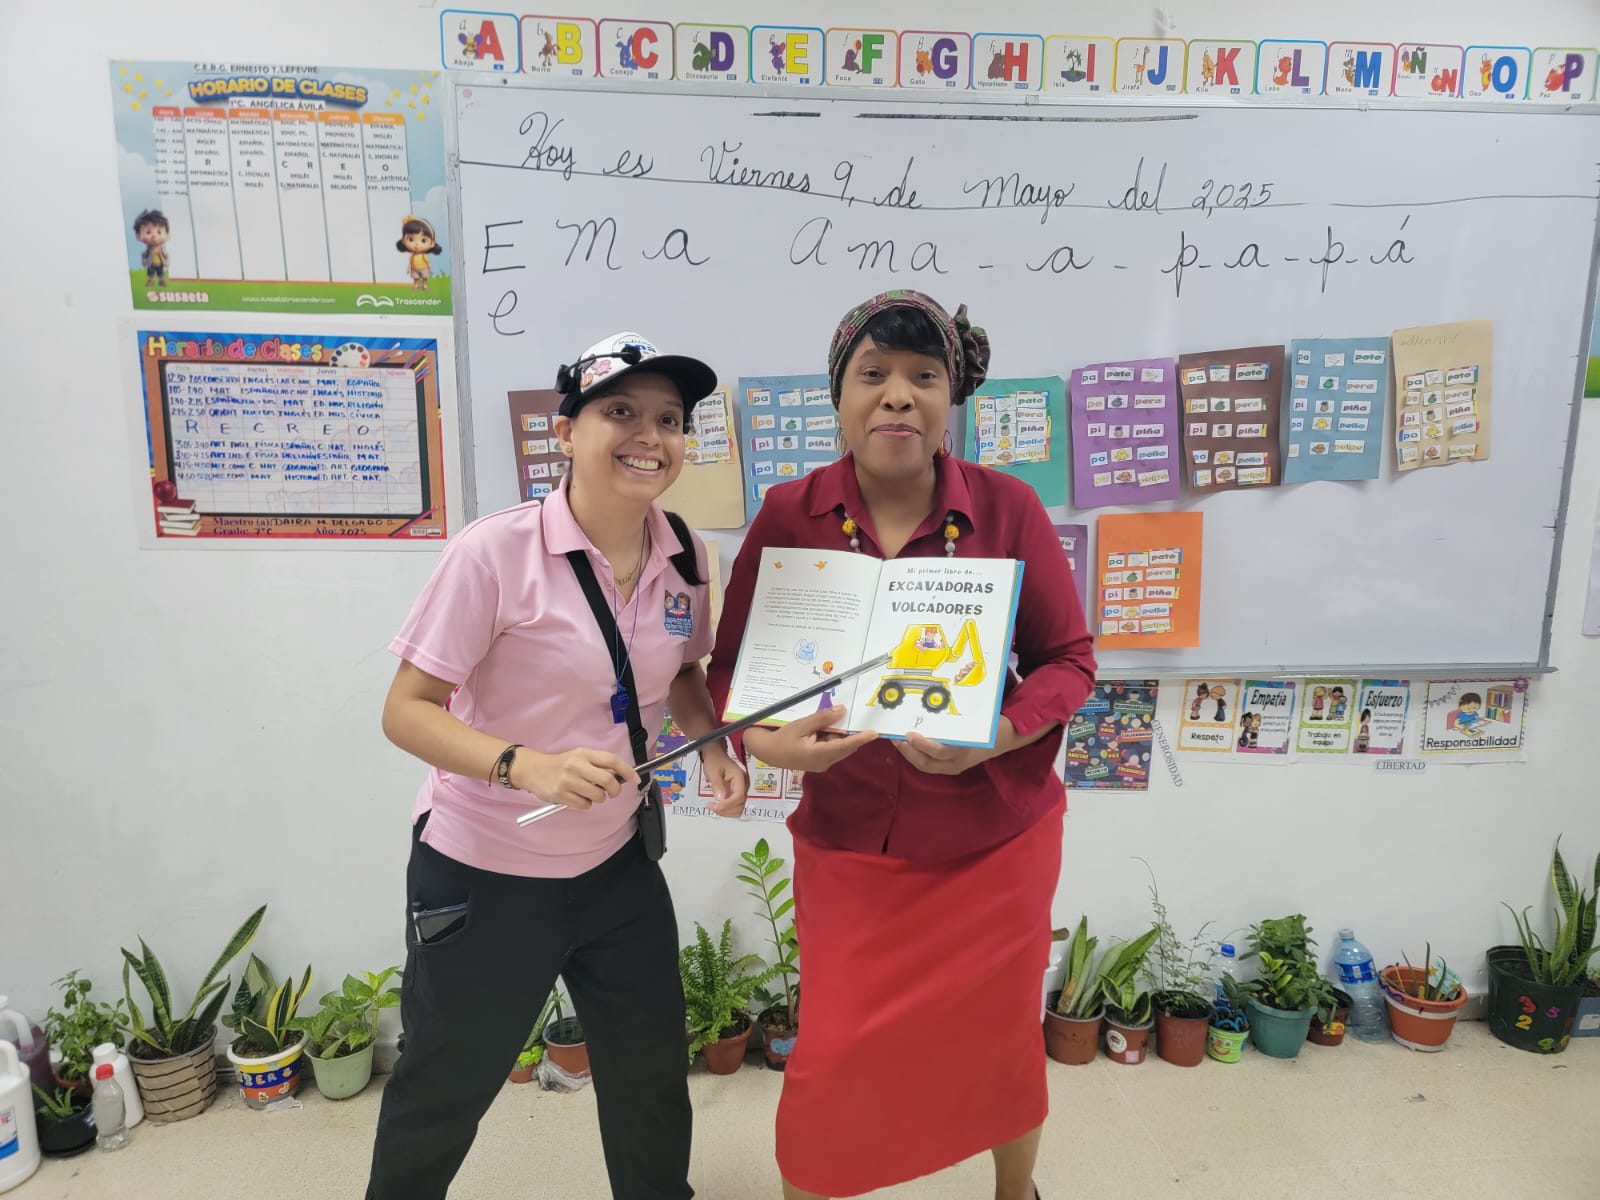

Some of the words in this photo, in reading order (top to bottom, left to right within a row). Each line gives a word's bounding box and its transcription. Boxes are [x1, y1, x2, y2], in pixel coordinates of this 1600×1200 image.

[477, 20, 504, 61] A
[557, 23, 583, 64] B
[631, 27, 658, 69] C
[710, 32, 735, 71] D
[785, 32, 808, 74] E
[862, 34, 885, 73] F
[931, 38, 958, 79] G
[1004, 42, 1028, 81] H
[1087, 43, 1096, 82] I
[1147, 46, 1168, 85] J
[1410, 46, 1427, 74] Ñ
[230, 65, 271, 73] ERNESTO
[1215, 48, 1241, 85] K
[1291, 49, 1309, 86] L
[1354, 51, 1382, 89] M
[1562, 53, 1584, 92] P
[1440, 69, 1458, 93] N
[1491, 56, 1518, 93] O
[189, 78, 268, 98] HORARIO
[272, 78, 296, 93] DE
[300, 80, 368, 103] CLASES
[251, 99, 296, 109] ANGÉLICA
[298, 100, 325, 111] ÁVILA
[603, 150, 654, 178] es
[700, 141, 811, 194] Viernes
[873, 157, 924, 211] de
[963, 173, 1075, 225] Mayo
[1108, 157, 1168, 215] del
[395, 297, 442, 306] Trascender
[148, 336, 224, 359] Horario
[228, 338, 257, 359] de
[260, 337, 323, 361] Clases
[1355, 353, 1382, 361] pato
[1082, 374, 1097, 383] pa
[1106, 370, 1132, 379] pato
[1189, 375, 1204, 383] pa
[1237, 369, 1263, 378] pato
[1408, 379, 1422, 387] pa
[1447, 371, 1472, 381] pato
[699, 398, 723, 408] pato
[753, 394, 769, 404] pa
[805, 393, 831, 403] pato
[980, 402, 993, 411] pa
[1018, 397, 1044, 405] pato
[1295, 401, 1304, 409] pi
[1449, 405, 1471, 415] piña
[1406, 415, 1415, 423] pi
[186, 419, 199, 434] R
[221, 423, 232, 434] E
[253, 422, 265, 433] C
[286, 423, 300, 433] R
[323, 424, 333, 435] E
[357, 424, 370, 435] O
[1020, 425, 1045, 433] piña
[1136, 427, 1161, 436] piña
[1192, 425, 1203, 435] pi
[1238, 427, 1260, 435] piña
[1403, 431, 1418, 439] po
[758, 439, 770, 449] pi
[808, 439, 832, 448] piña
[981, 440, 994, 448] po
[1091, 455, 1106, 465] po
[757, 464, 771, 474] po
[213, 517, 253, 526] Maestro
[213, 527, 249, 536] Grado:
[314, 526, 337, 535] Año:
[340, 528, 367, 536] 2025
[1151, 552, 1176, 561] pato
[888, 580, 994, 594] EXCAVADORAS
[1148, 589, 1172, 597] piña
[891, 601, 984, 615] VOLCADORES
[1365, 690, 1403, 709] Esfuerzo
[1191, 732, 1225, 744] Respeto
[1308, 731, 1331, 739] Trabajo
[1313, 739, 1334, 747] equipo
[1426, 735, 1518, 750] Responsabilidad
[1151, 719, 1184, 788] GENEROSIDAD
[1376, 760, 1426, 771] LIBERTAD
[1519, 995, 1537, 1013] 3
[1515, 1014, 1533, 1030] 2
